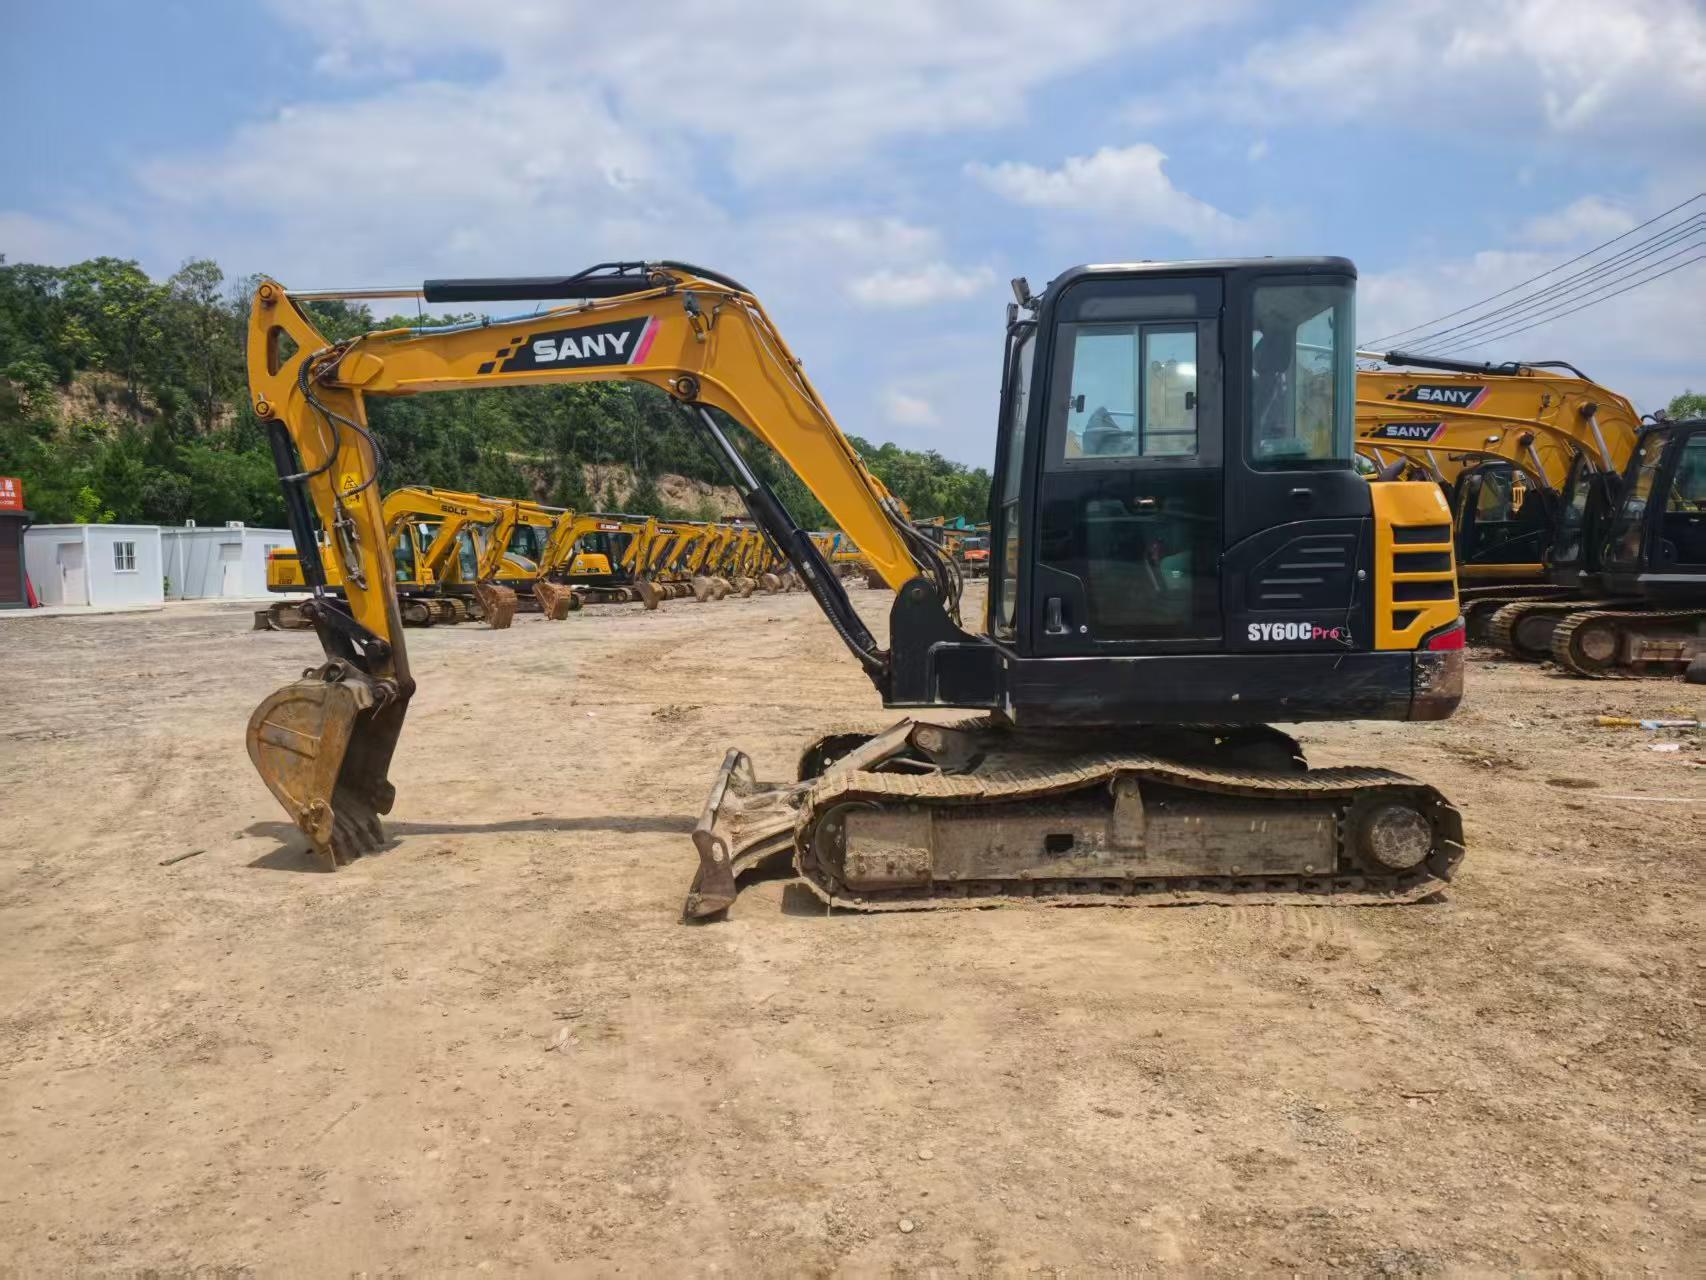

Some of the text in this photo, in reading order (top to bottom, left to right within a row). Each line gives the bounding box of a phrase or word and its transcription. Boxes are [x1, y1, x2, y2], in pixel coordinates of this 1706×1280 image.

[533, 331, 630, 363] SANY
[1416, 388, 1472, 403] SANY
[1386, 426, 1432, 437] SANY
[441, 504, 468, 516] SDLG
